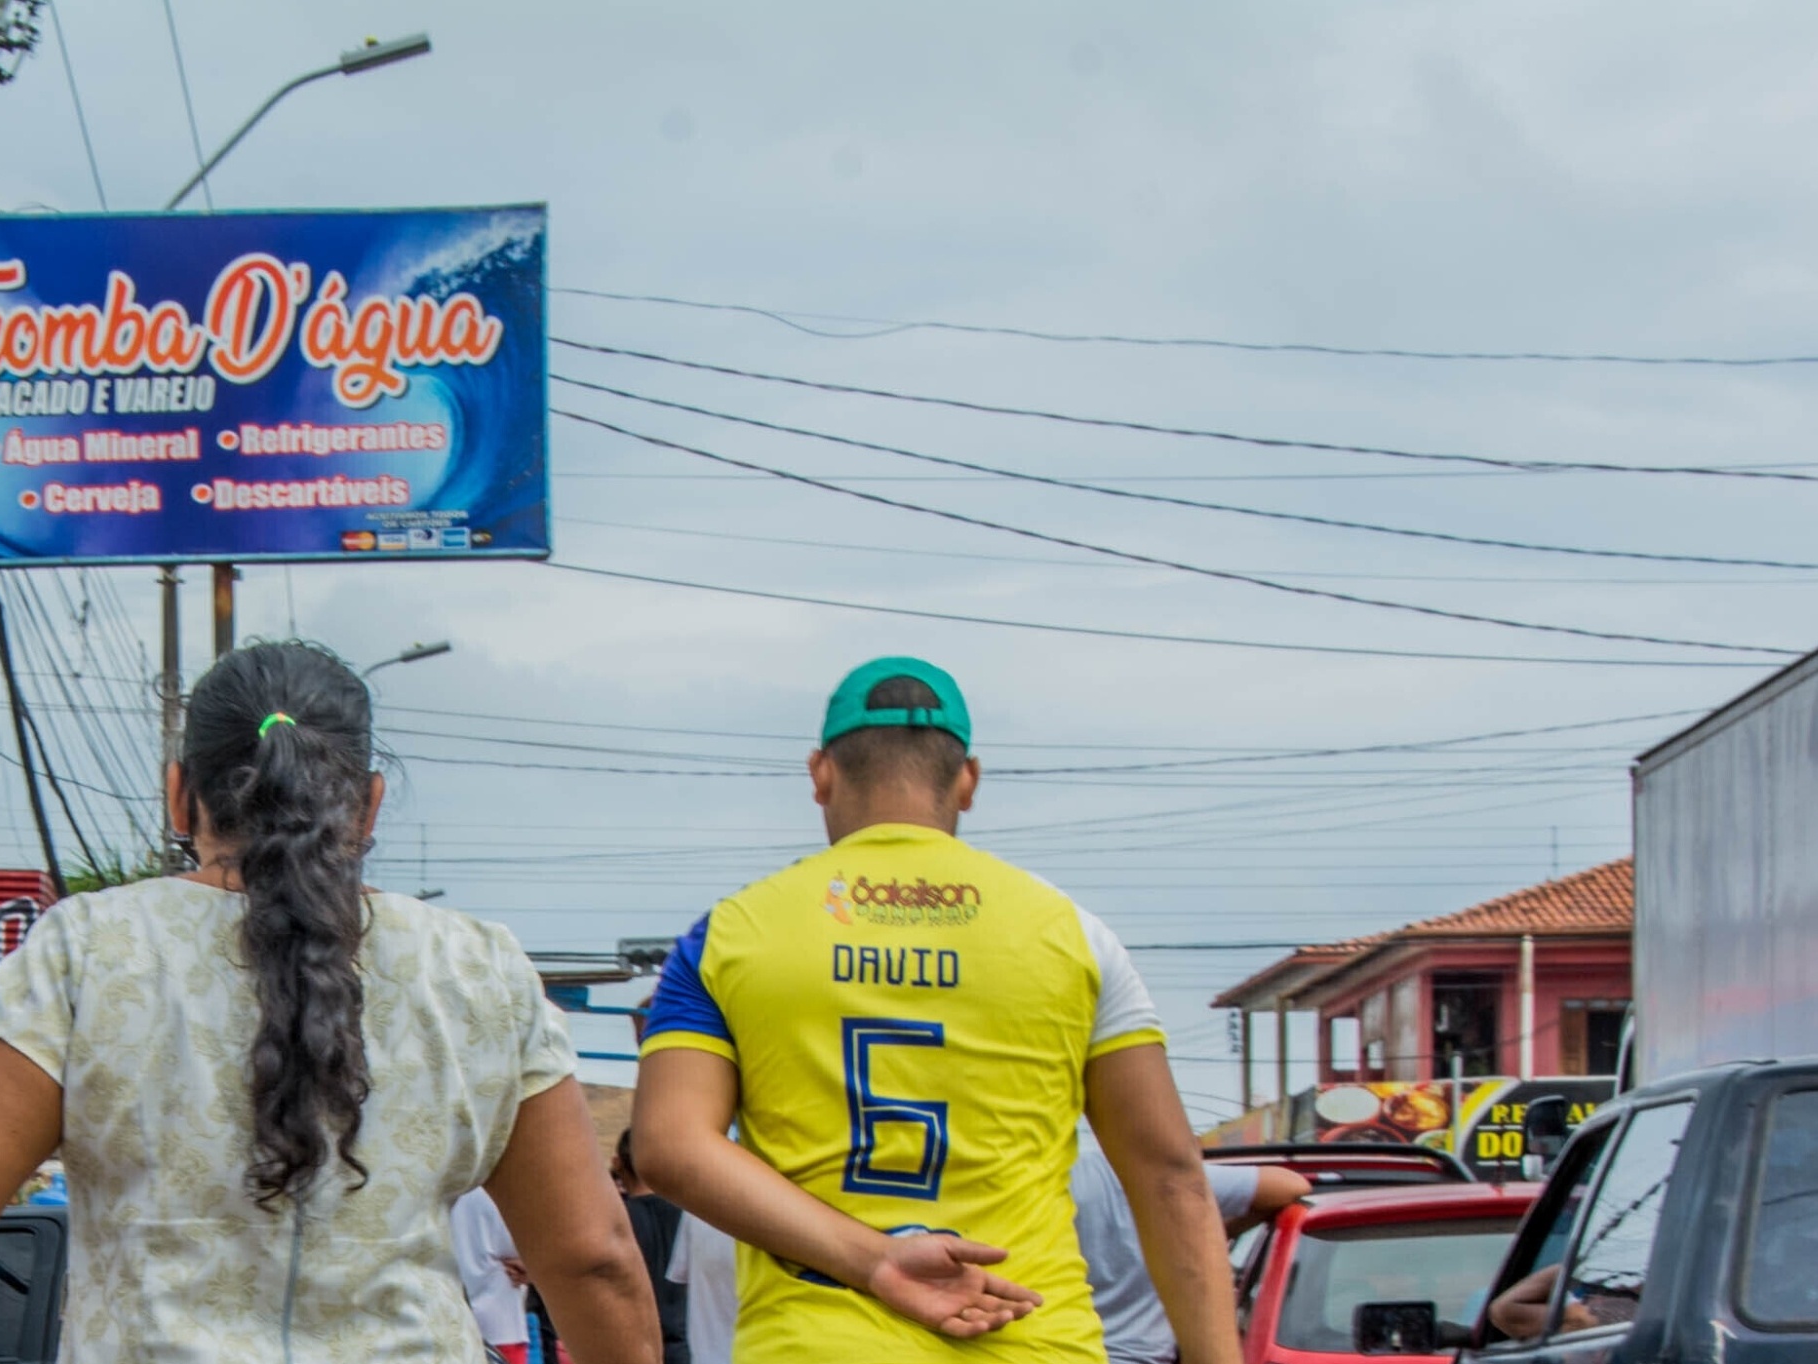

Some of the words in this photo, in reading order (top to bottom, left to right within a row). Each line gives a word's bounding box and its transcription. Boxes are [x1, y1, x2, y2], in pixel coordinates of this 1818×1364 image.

[202, 252, 503, 409] D'água
[92, 378, 112, 414] E
[113, 374, 216, 414] VAREJO
[3, 428, 81, 467] Água
[83, 427, 200, 463] Mineral
[239, 422, 446, 456] Refrigerantes
[42, 479, 162, 515] Cerveja
[212, 474, 410, 510] Descartáveis
[833, 944, 959, 988] DAVID
[841, 1016, 949, 1202] 6
